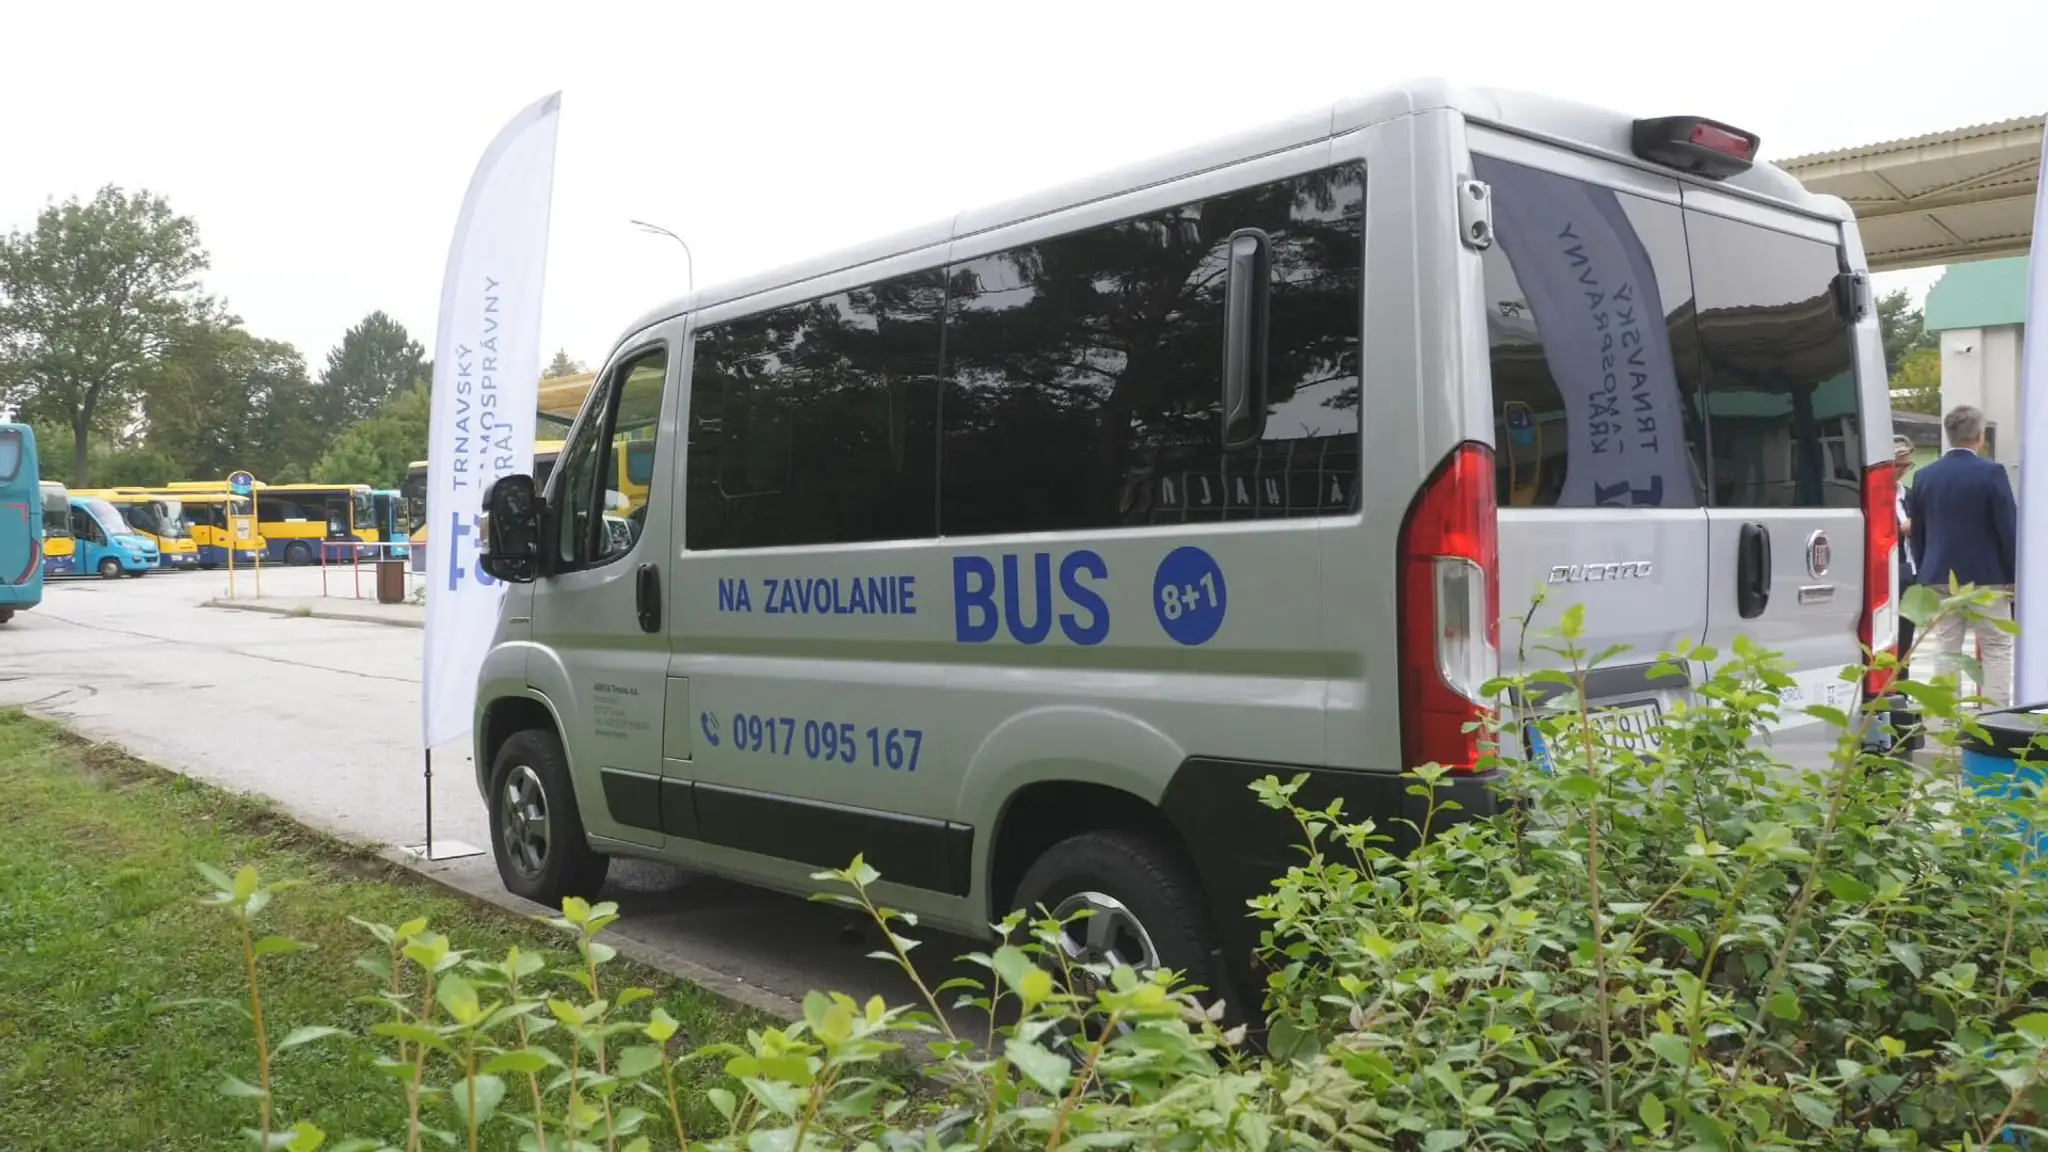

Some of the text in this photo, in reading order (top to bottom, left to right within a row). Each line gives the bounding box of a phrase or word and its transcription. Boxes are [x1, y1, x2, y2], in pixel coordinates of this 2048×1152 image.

[453, 343, 473, 491] TRNAVSKÝ
[493, 422, 514, 478] RAJ
[718, 549, 1218, 647] NA ZAVOLANIE BUS 8+1
[1547, 561, 1653, 584] DUCATO
[733, 713, 923, 772] 0917 095 167
